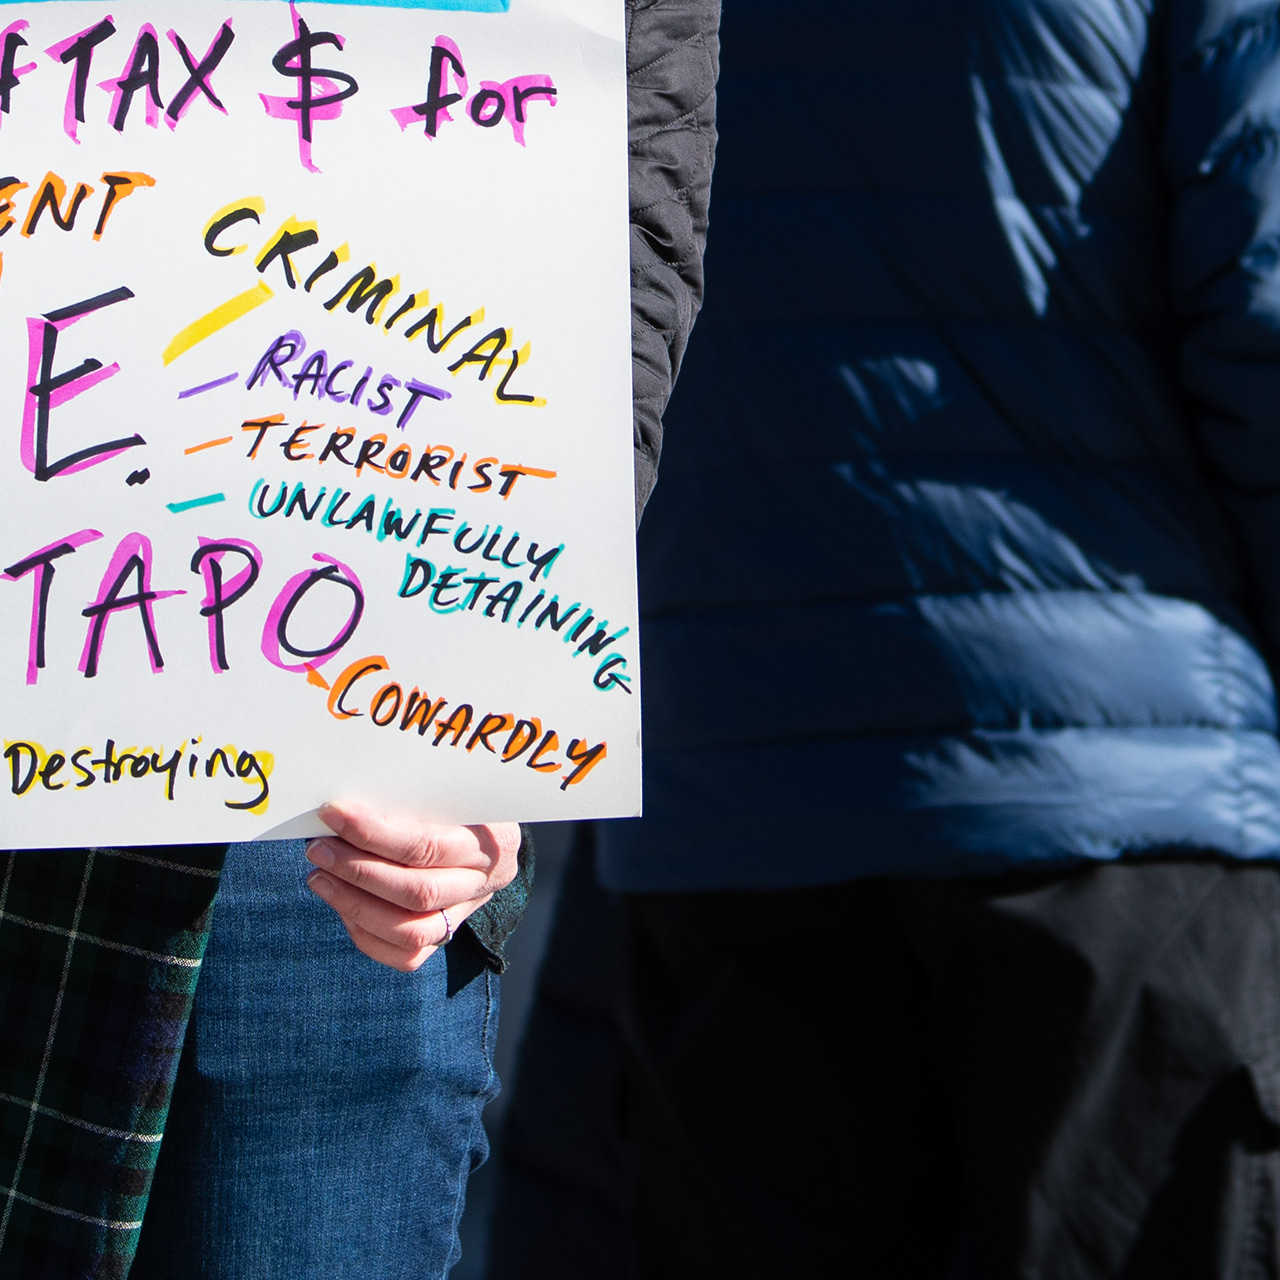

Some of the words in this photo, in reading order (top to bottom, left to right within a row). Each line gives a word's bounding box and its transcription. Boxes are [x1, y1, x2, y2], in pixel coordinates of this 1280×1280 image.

[43, 14, 237, 145] TAX
[390, 34, 559, 148] for
[202, 195, 548, 407] CRIMINAL
[244, 328, 453, 431] RACIST
[240, 411, 558, 501] TERRORIST
[246, 477, 566, 582] UNLAWFULLY
[397, 552, 633, 696] DETAINING
[3, 734, 276, 815] Destroying
[326, 654, 608, 791] COWARDLY
